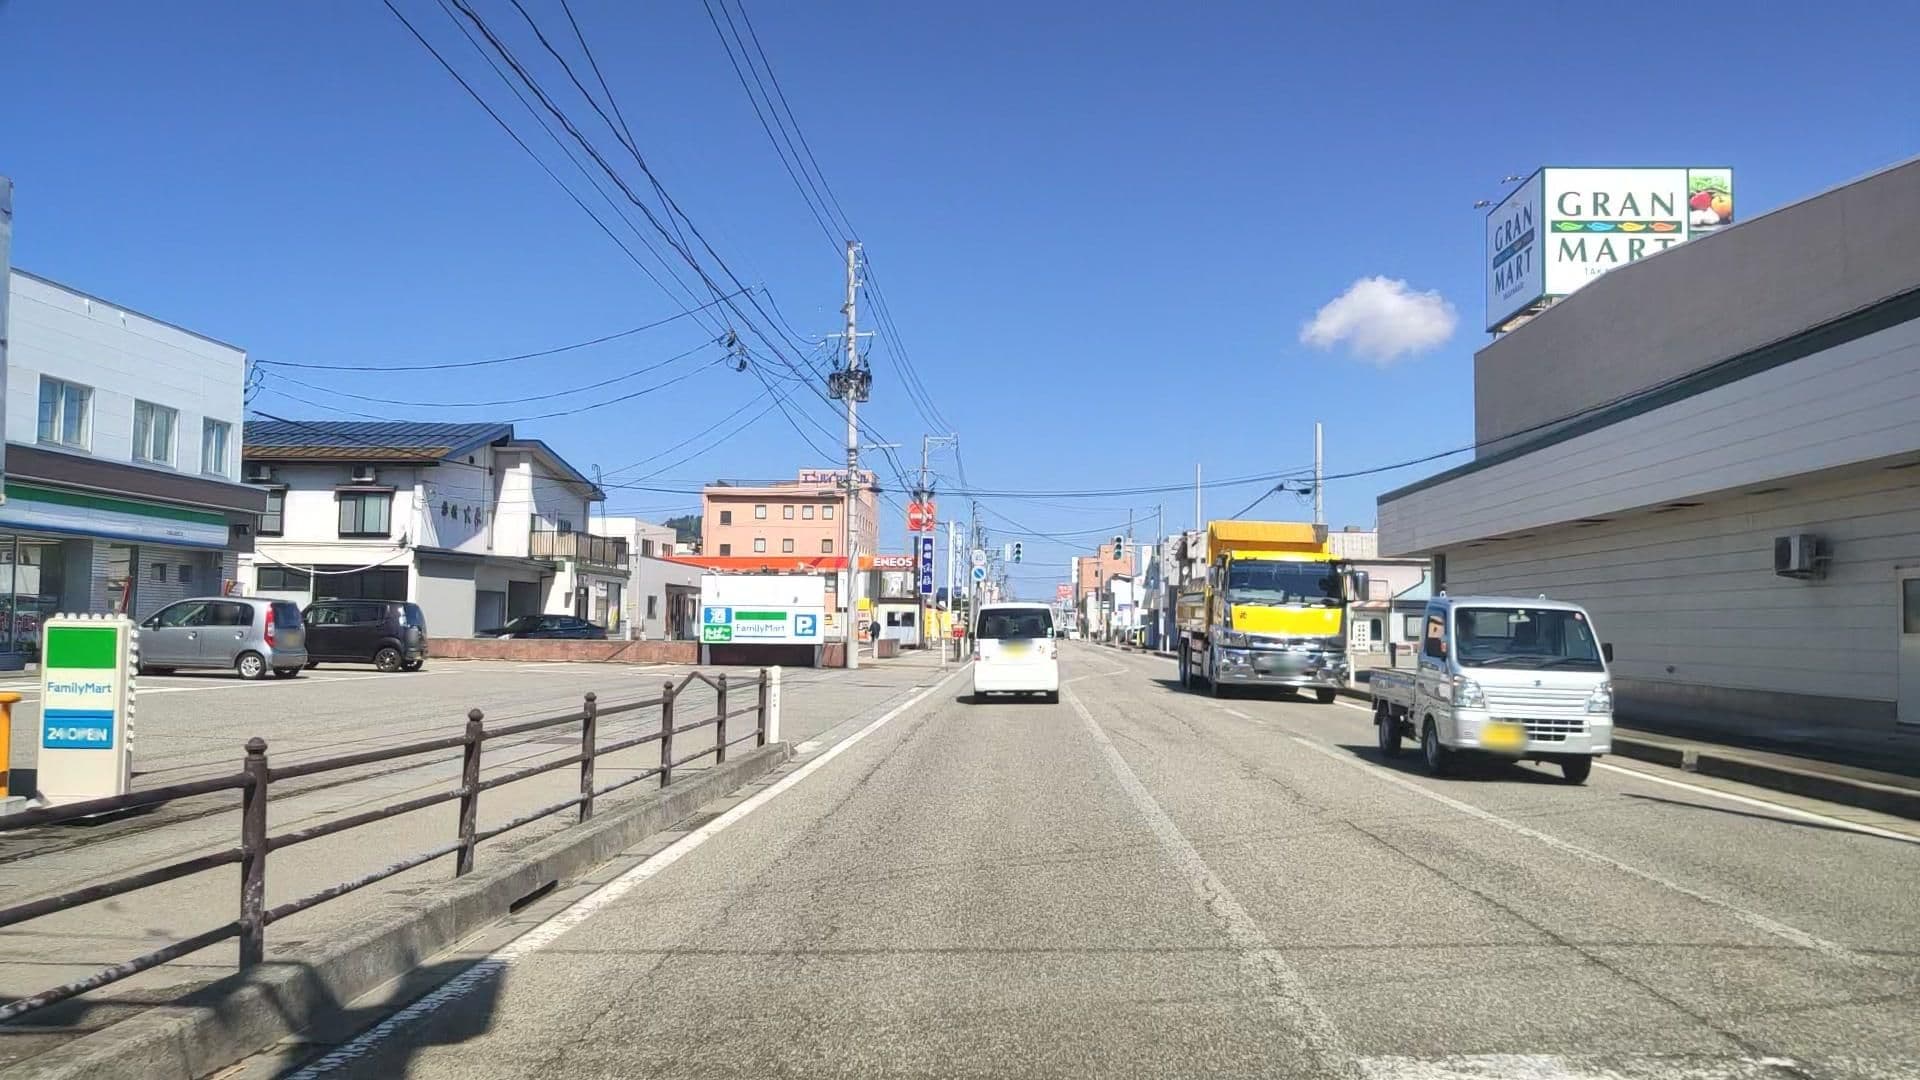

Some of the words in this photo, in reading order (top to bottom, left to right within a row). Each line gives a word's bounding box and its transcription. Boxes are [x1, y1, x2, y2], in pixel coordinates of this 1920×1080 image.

[1558, 191, 1674, 217] GRAN
[1494, 200, 1533, 252] GRAN
[1494, 246, 1533, 297] MART
[873, 557, 913, 567] ENEOS
[736, 624, 785, 634] FamilyMart
[47, 681, 112, 695] FamilyMart
